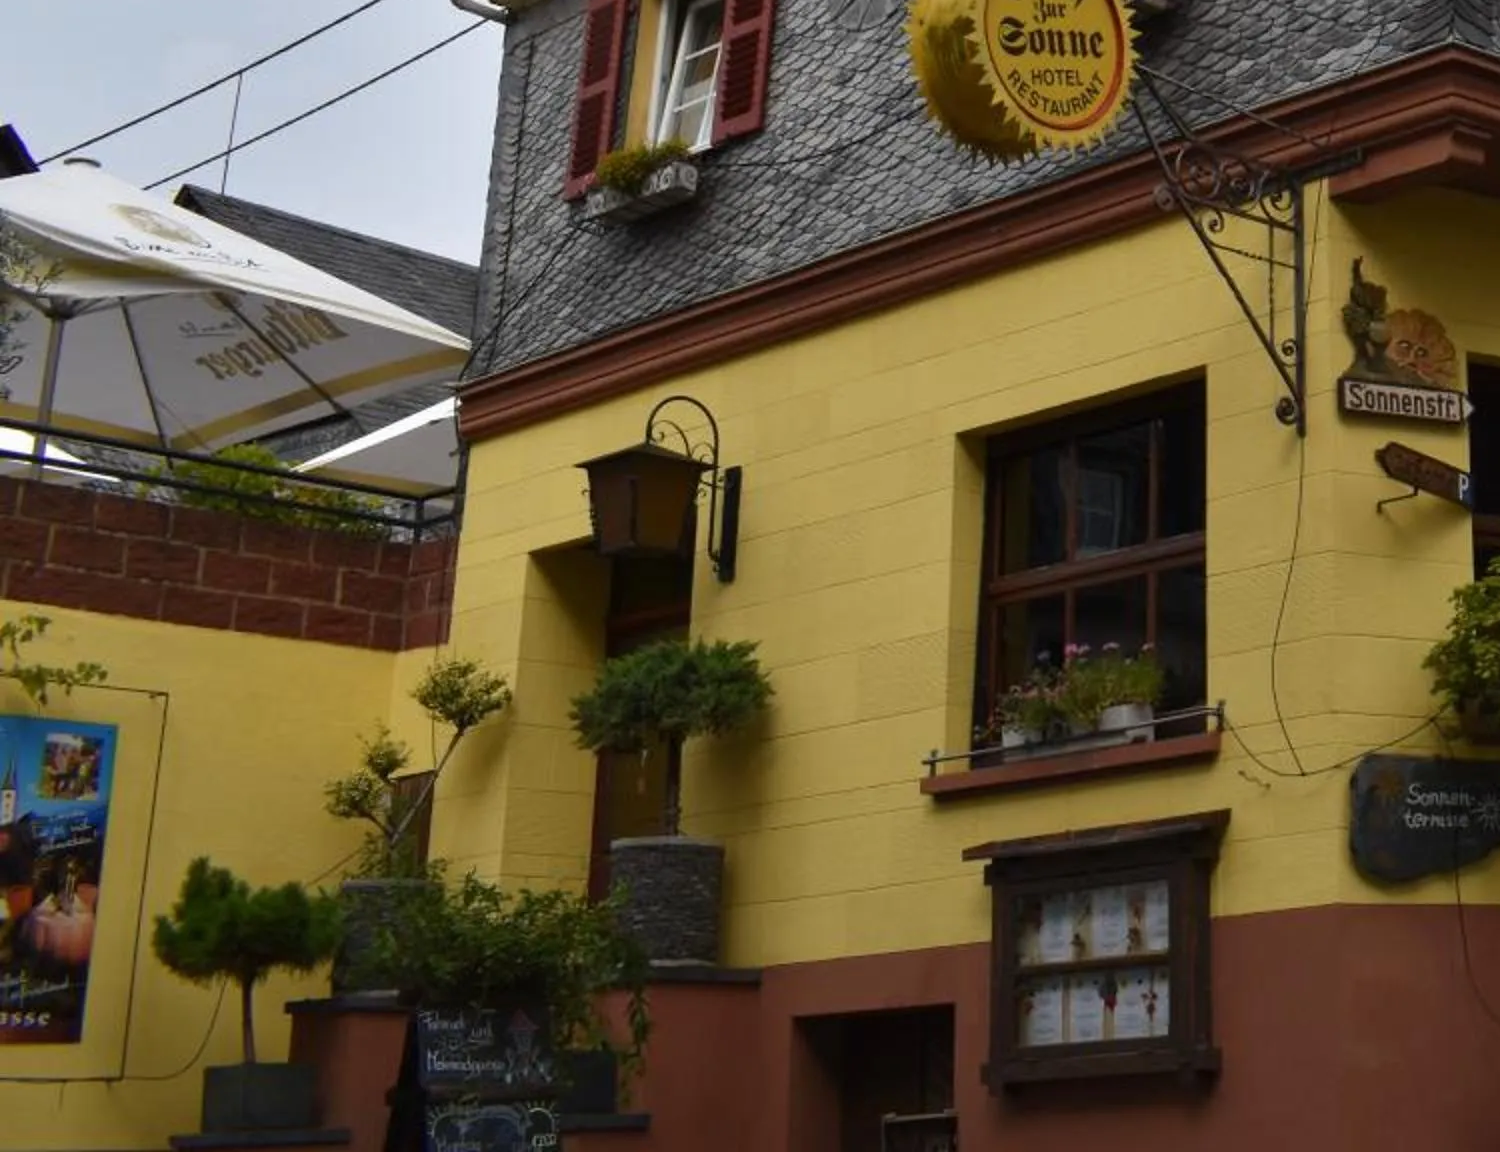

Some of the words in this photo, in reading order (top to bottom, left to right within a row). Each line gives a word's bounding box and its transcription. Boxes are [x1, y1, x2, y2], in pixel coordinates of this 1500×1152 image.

[999, 16, 1105, 59] Sonne
[1007, 69, 1105, 117] RESTAURANT
[1031, 69, 1084, 87] HOTEL
[1349, 383, 1458, 419] Sonnenstr.
[1458, 473, 1469, 501] P
